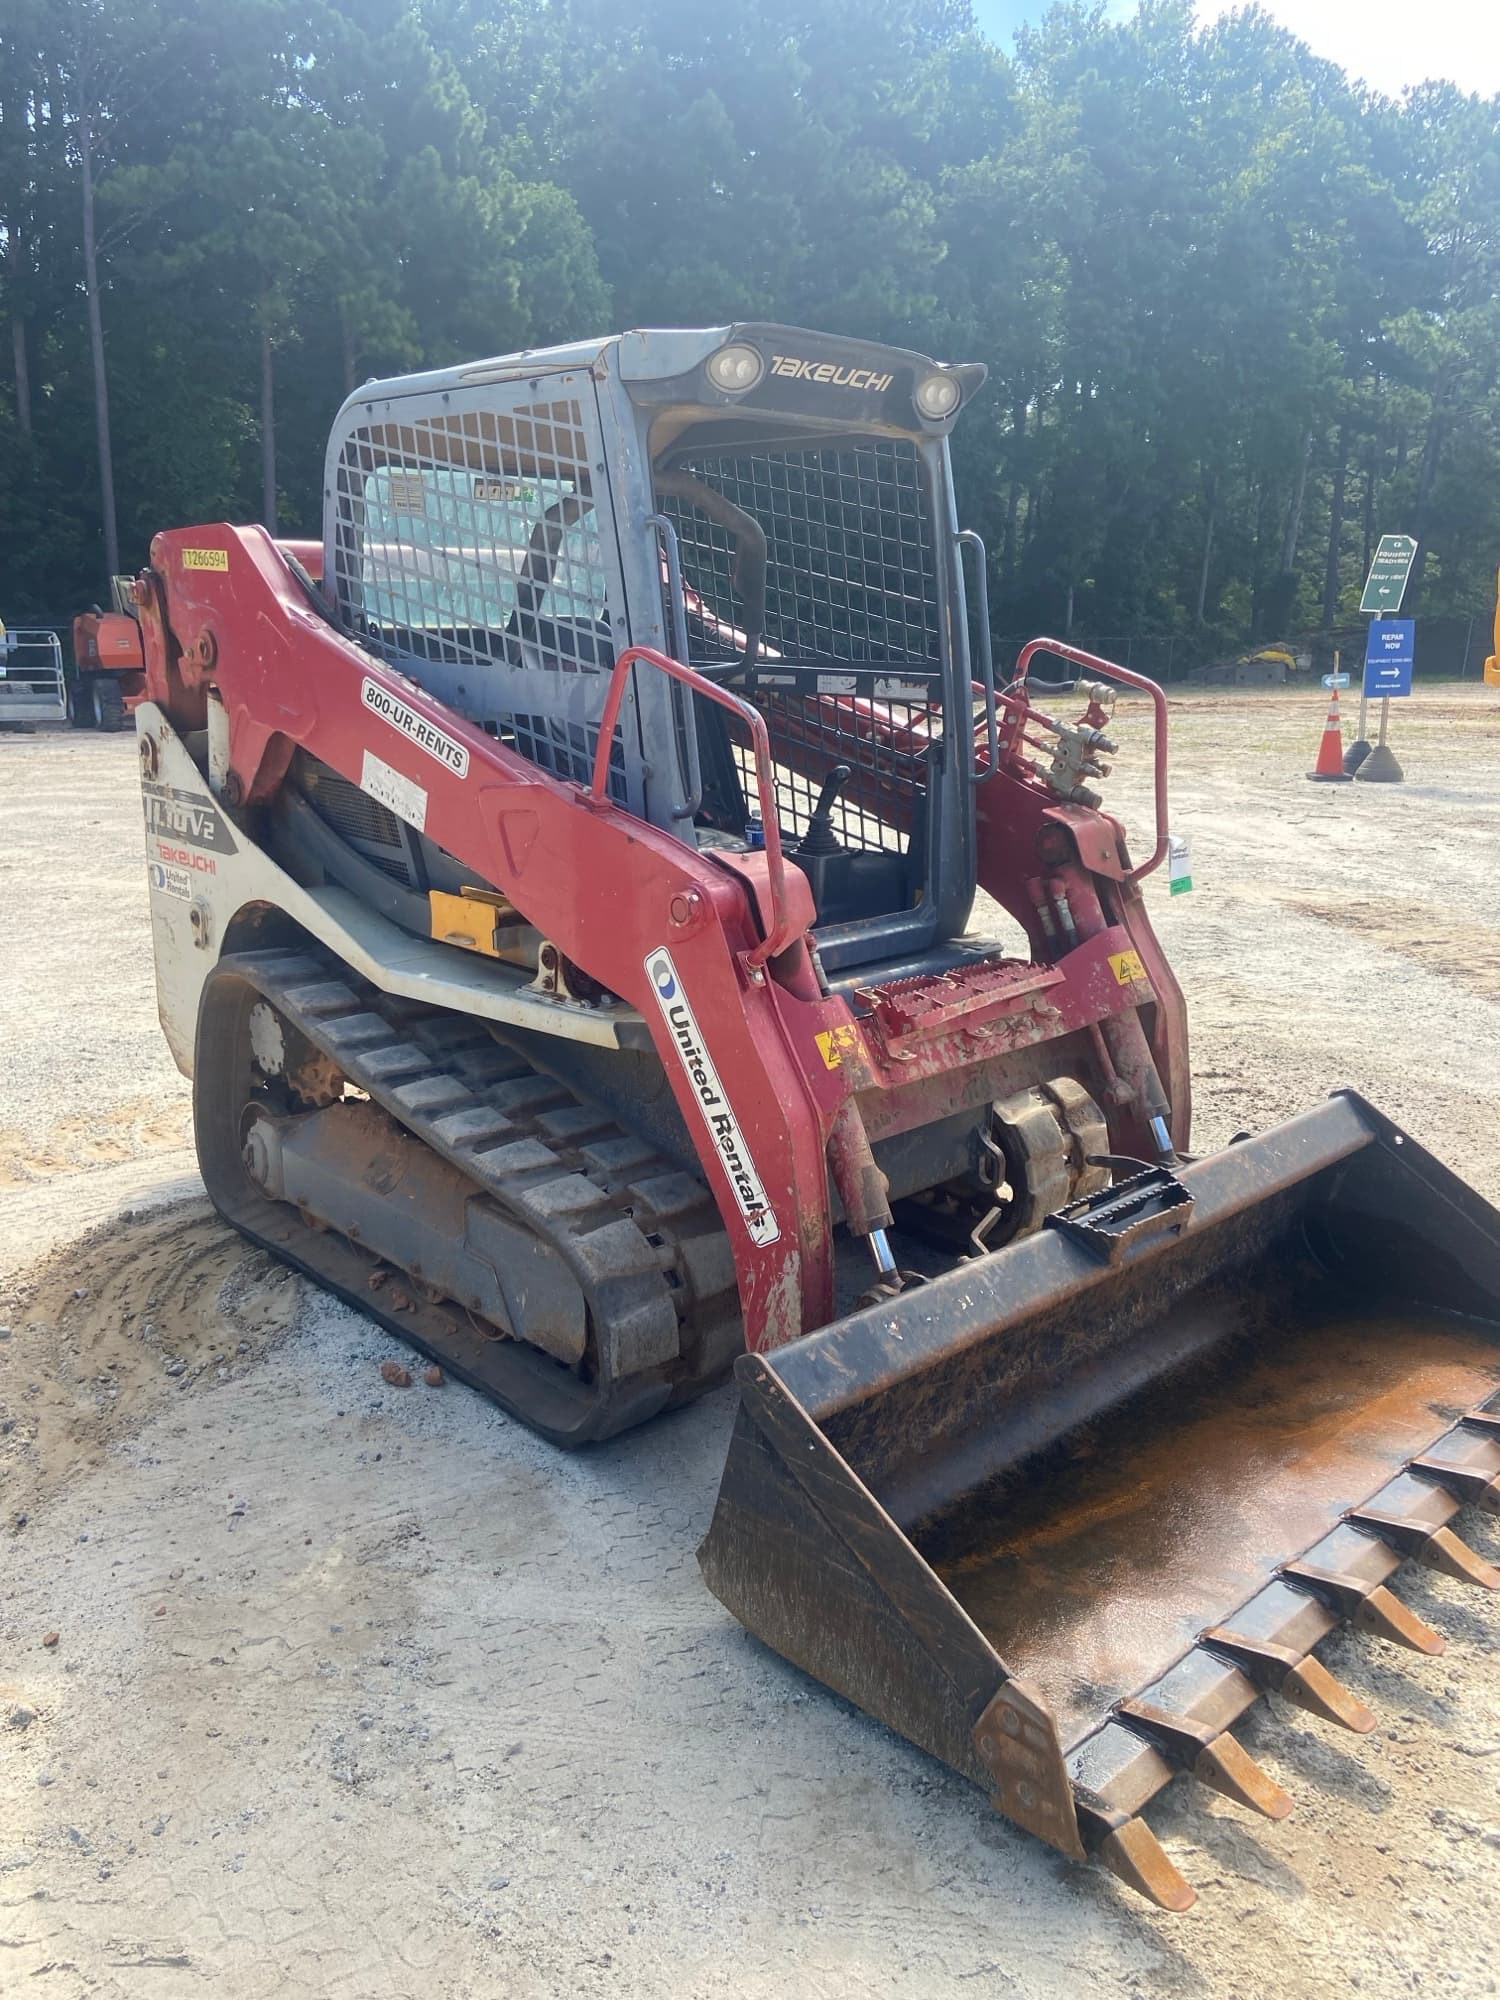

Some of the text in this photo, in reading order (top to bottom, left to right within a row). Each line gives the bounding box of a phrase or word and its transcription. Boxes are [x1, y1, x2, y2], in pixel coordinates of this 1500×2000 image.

[770, 355, 895, 392] TAKEUCHI
[366, 687, 463, 769] 800-UR-RENTS
[156, 841, 217, 876] TAKEUCHI
[166, 868, 188, 886] United
[166, 880, 190, 899] Rentals
[669, 1005, 721, 1106] United
